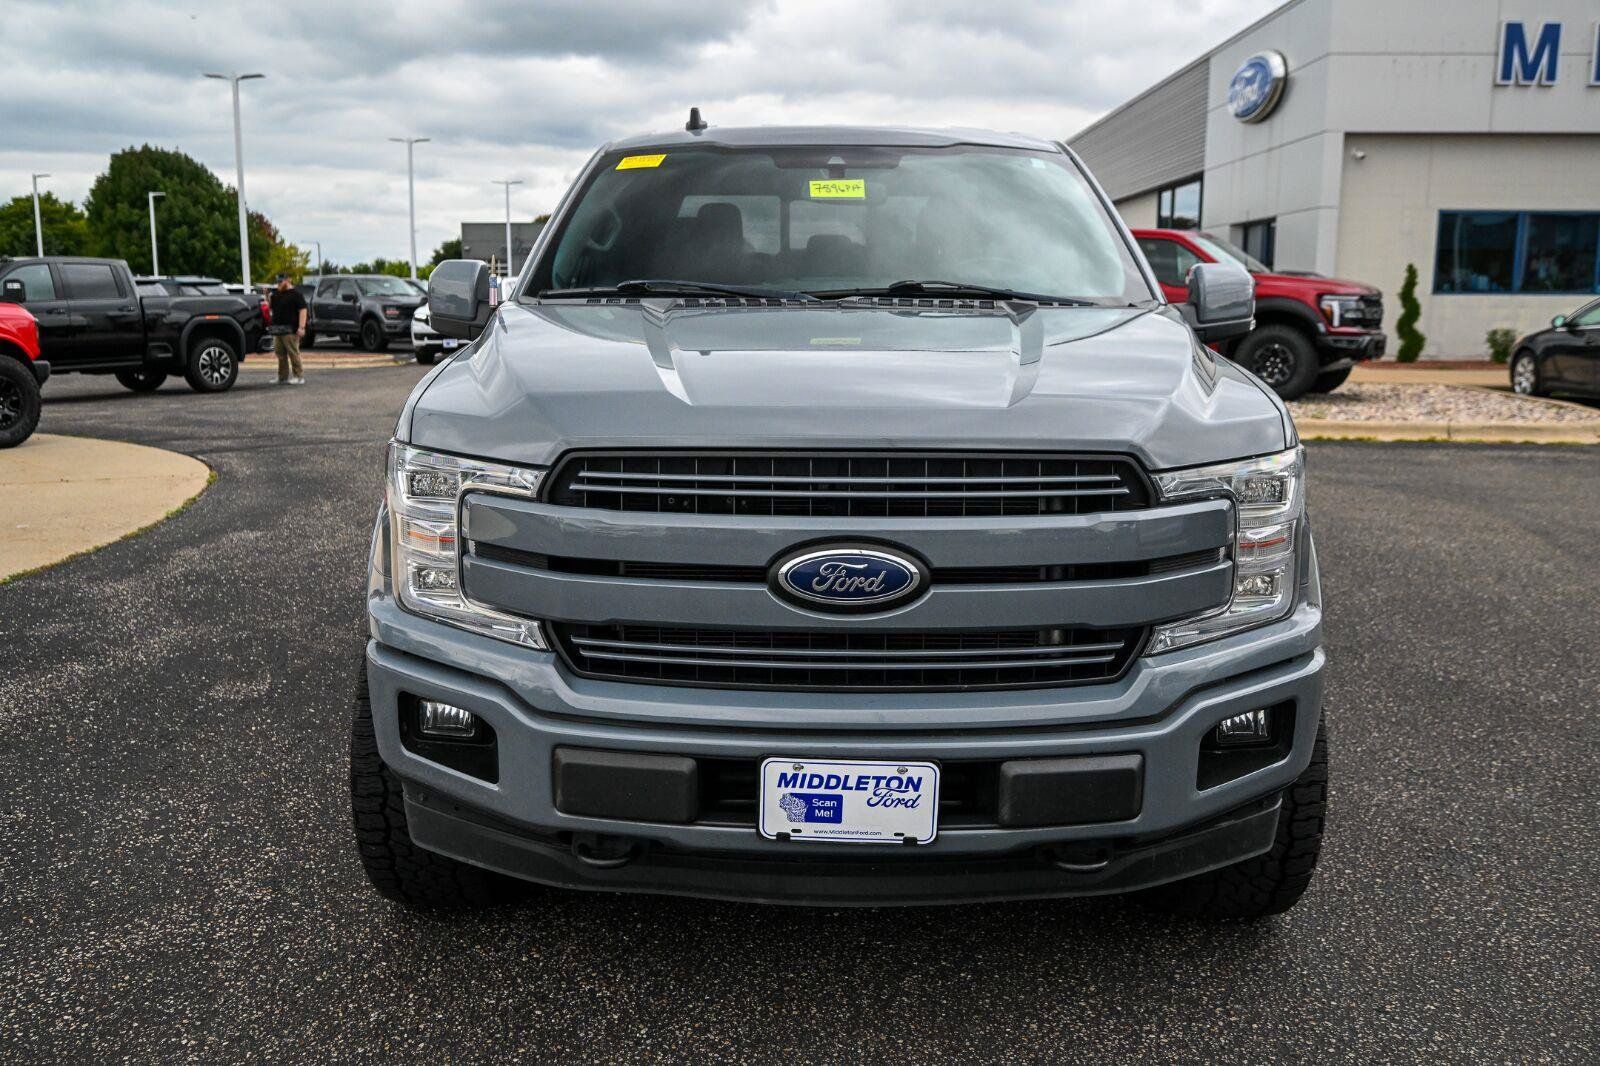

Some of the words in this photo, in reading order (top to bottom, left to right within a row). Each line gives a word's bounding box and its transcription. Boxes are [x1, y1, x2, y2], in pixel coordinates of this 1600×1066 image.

[1499, 20, 1600, 86] M
[811, 561, 887, 593] Ford
[776, 772, 923, 793] MIDDLETON
[811, 797, 838, 808] Scan
[866, 786, 922, 809] Ford
[814, 808, 834, 818] Me!
